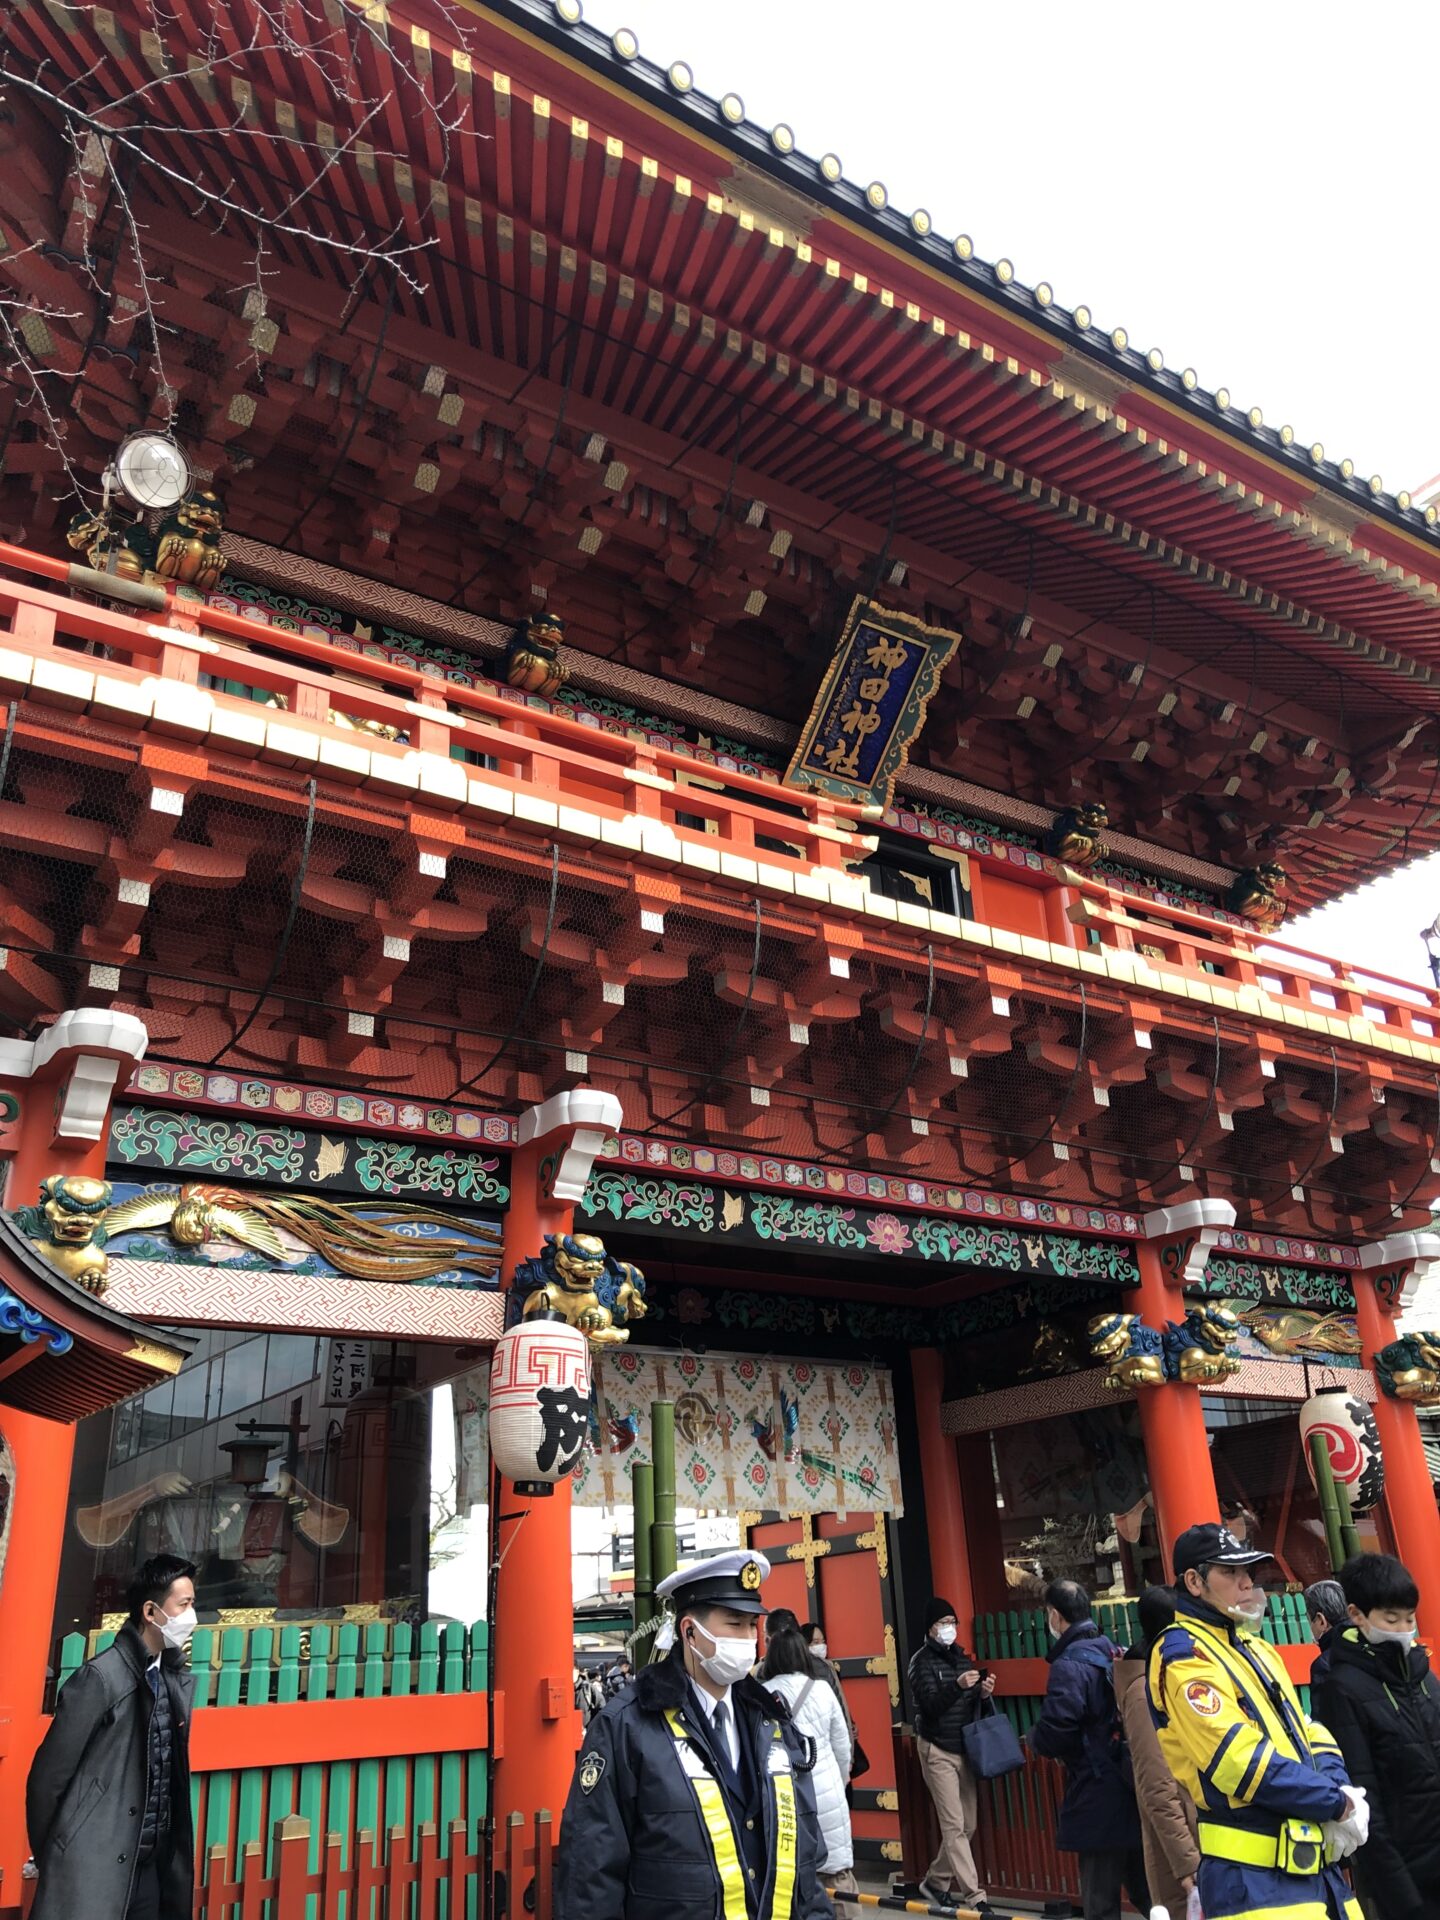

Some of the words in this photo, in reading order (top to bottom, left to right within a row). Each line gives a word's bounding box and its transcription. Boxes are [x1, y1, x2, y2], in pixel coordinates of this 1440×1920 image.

[824, 636, 908, 779] 神田神社
[780, 1791, 794, 1852] 警視庁
